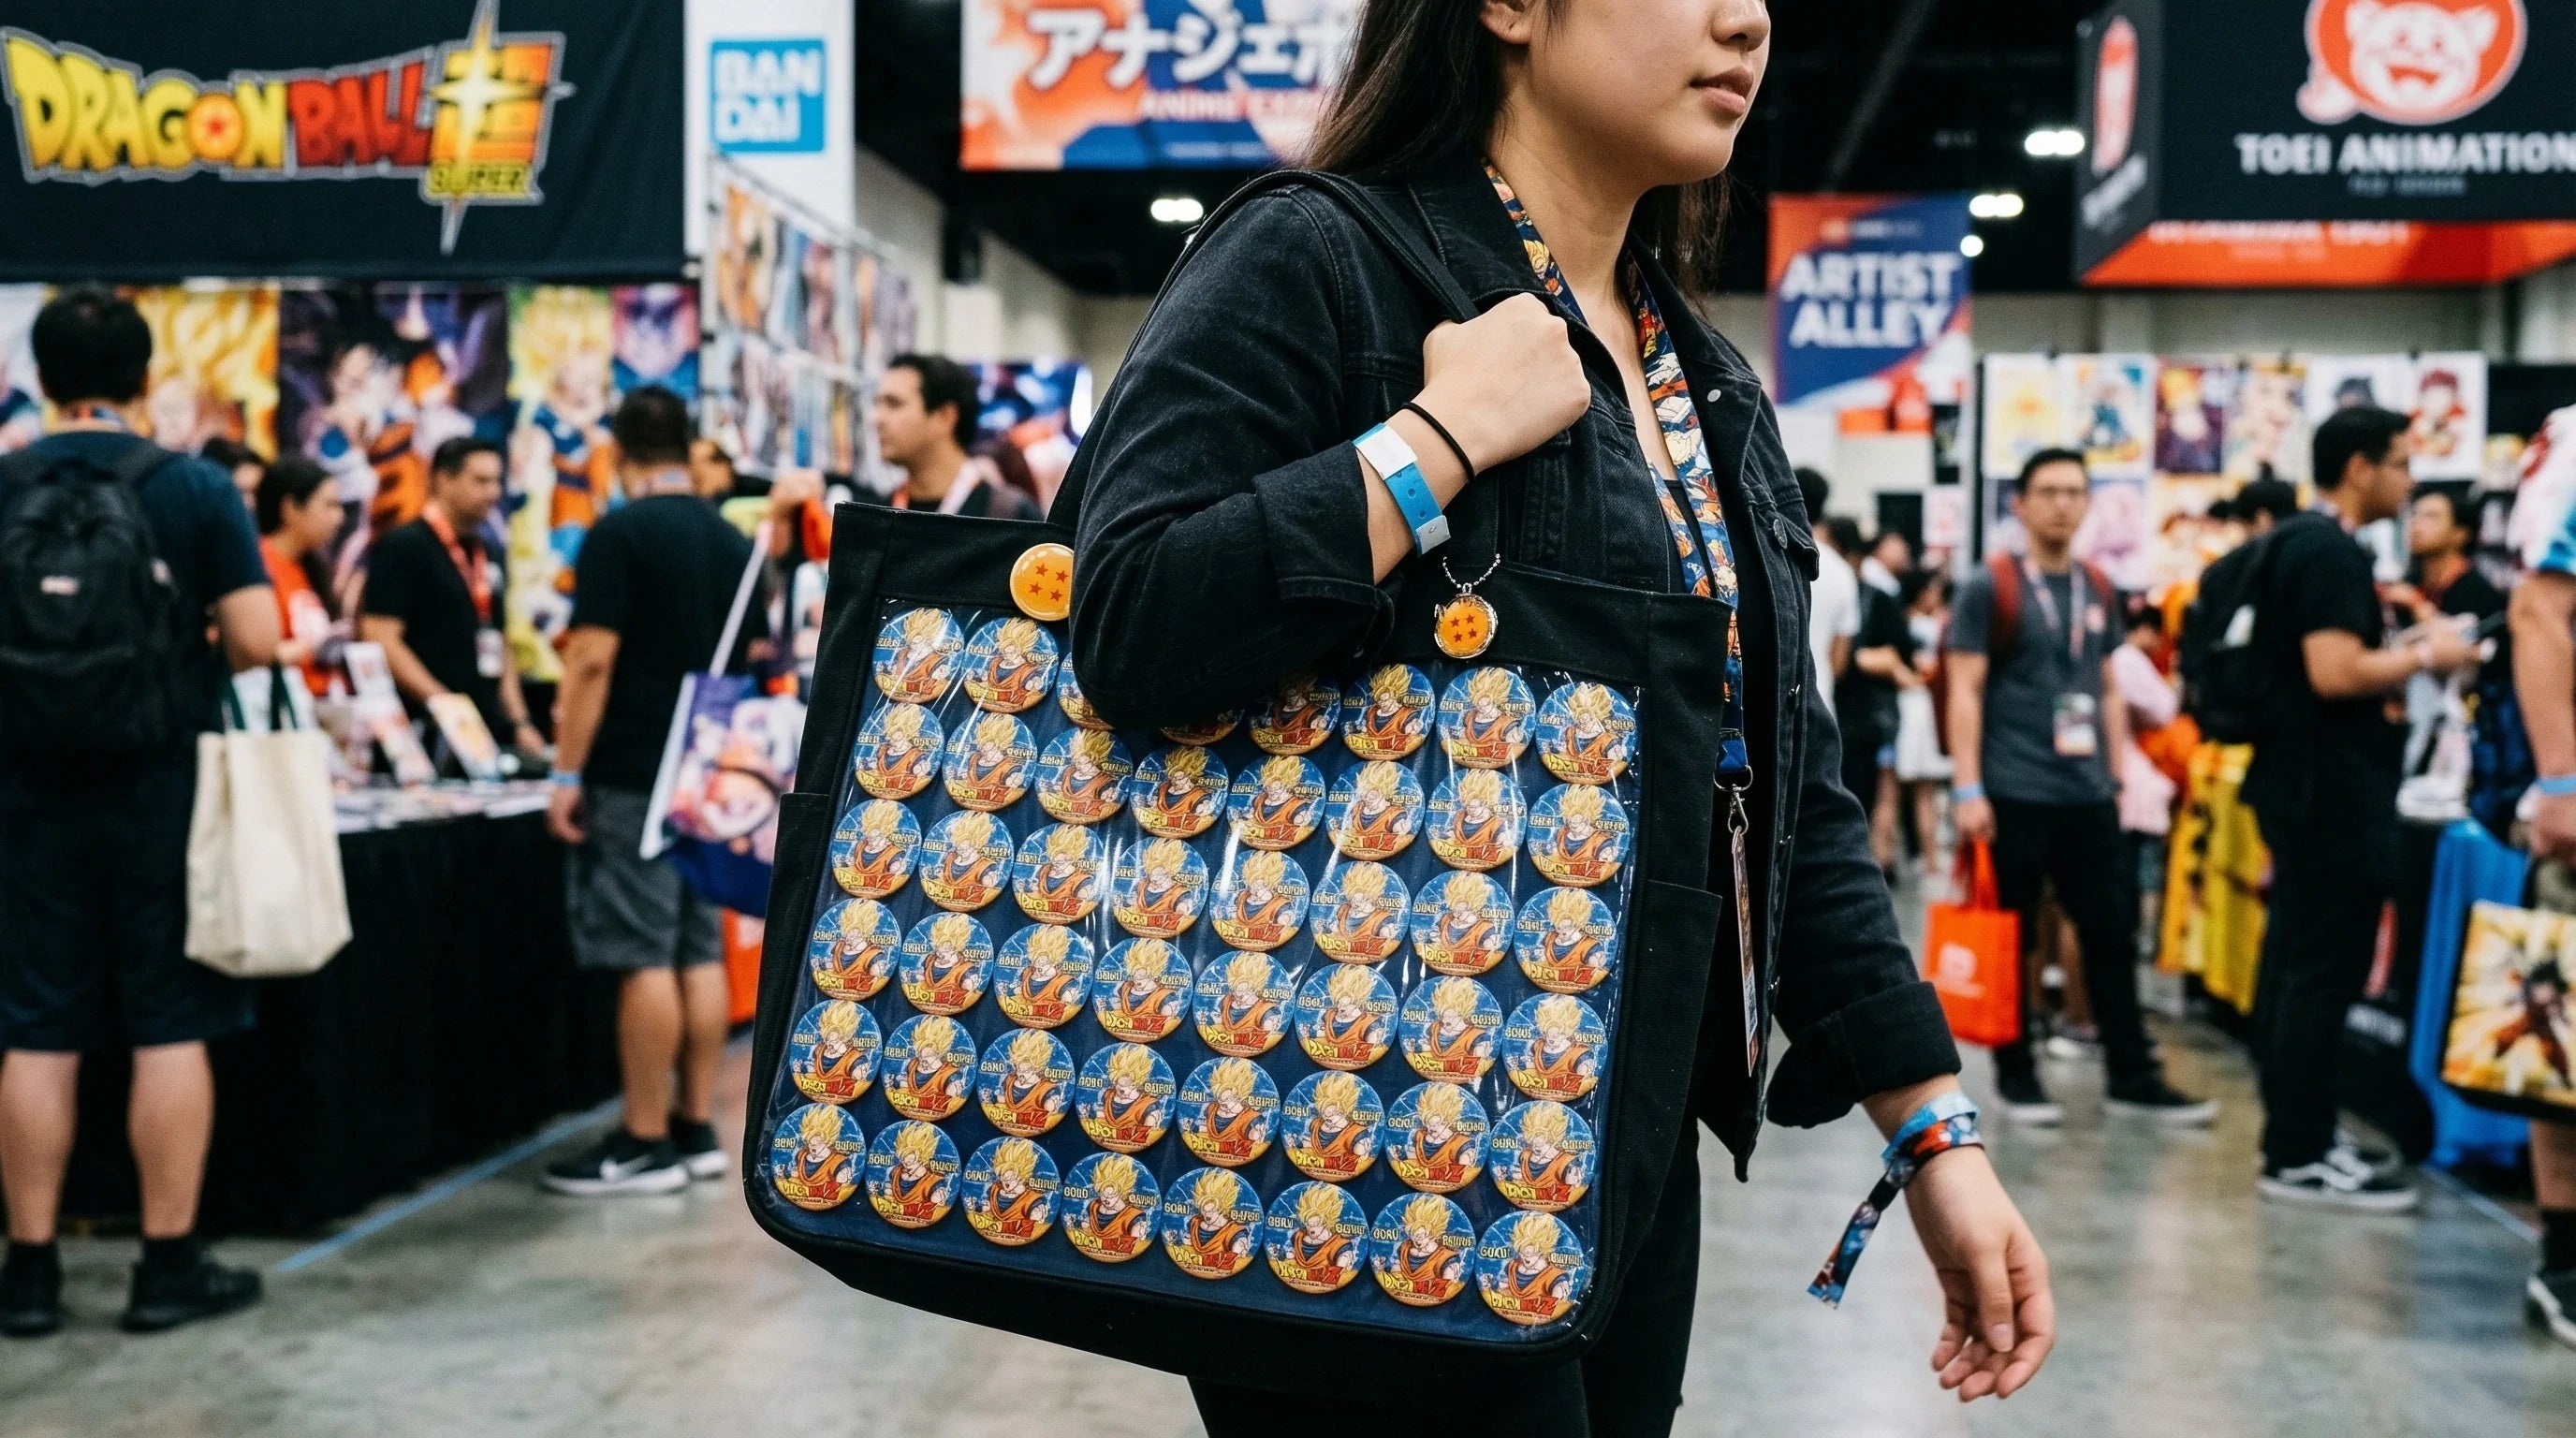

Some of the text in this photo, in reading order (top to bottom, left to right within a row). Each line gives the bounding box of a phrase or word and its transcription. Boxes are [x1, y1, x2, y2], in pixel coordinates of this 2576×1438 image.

[715, 49, 822, 97] BAN
[5, 34, 432, 171] DRAGON BALL
[715, 97, 802, 142] DAI
[2233, 131, 2576, 175] TOEI ANIMATION
[1780, 251, 1964, 301] ARTIST
[1789, 298, 1953, 350] ALLEY
